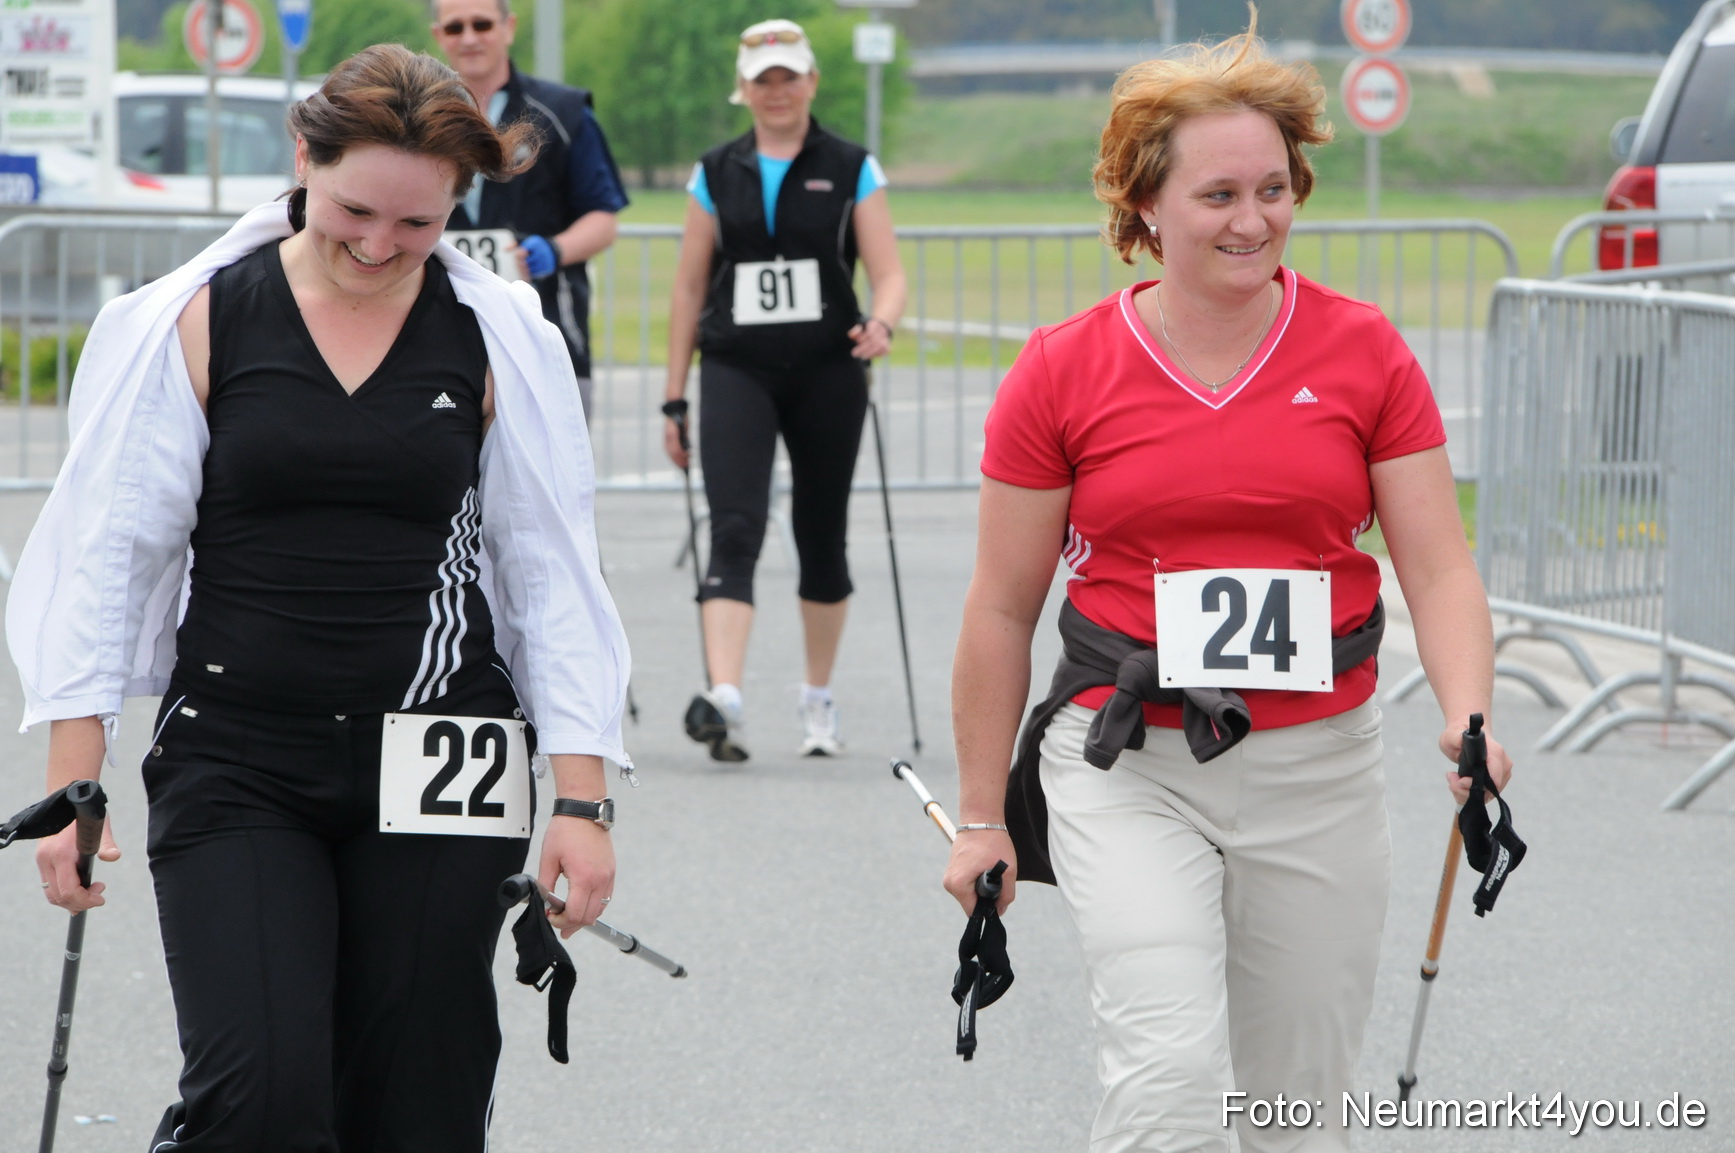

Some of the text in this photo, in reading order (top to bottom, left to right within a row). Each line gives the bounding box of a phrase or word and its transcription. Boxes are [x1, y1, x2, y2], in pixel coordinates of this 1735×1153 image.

[759, 268, 795, 311] 91
[1201, 576, 1298, 673] 24
[420, 720, 508, 818] 22
